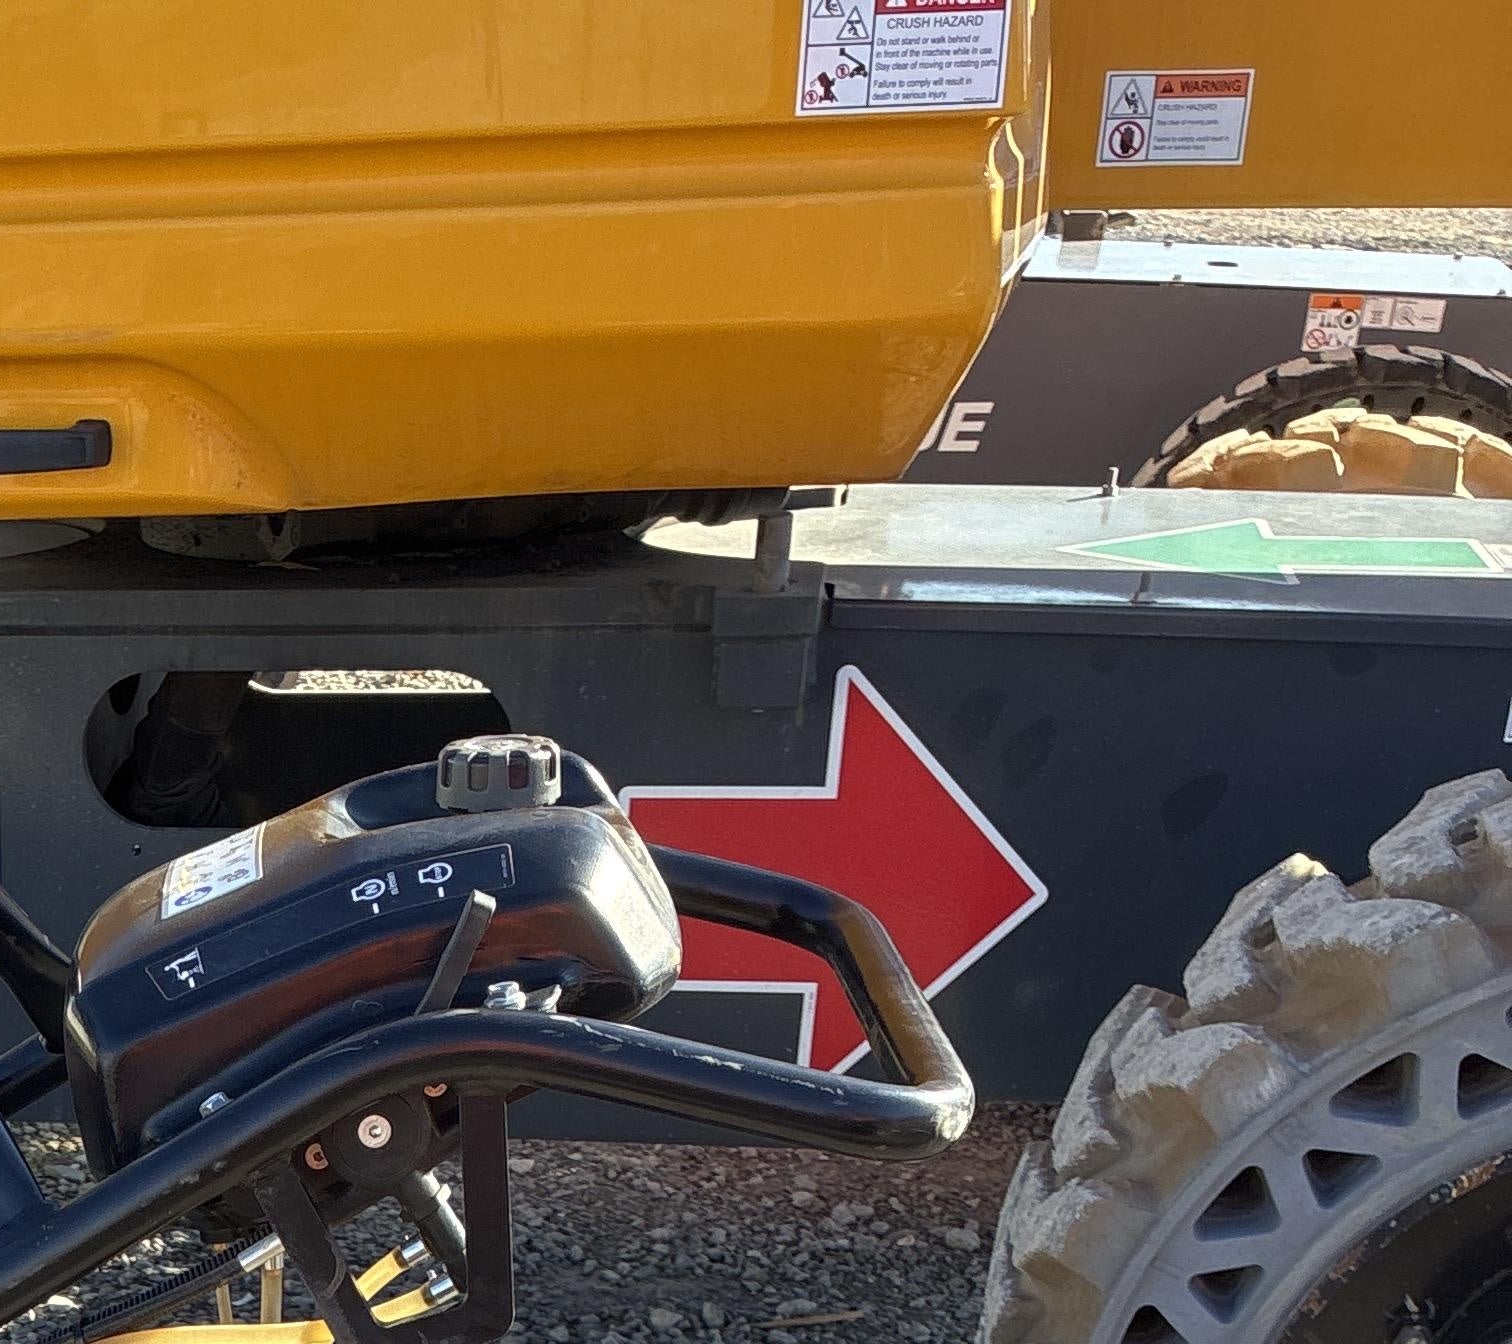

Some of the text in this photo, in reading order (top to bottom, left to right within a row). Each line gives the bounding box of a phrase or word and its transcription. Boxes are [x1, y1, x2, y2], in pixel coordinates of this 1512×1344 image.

[887, 15, 984, 29] CRUSH HAZARD
[877, 37, 886, 46] Do
[889, 37, 900, 45] not
[901, 36, 920, 45] stand
[930, 36, 946, 44] walk
[948, 35, 971, 43] behind
[884, 50, 900, 58] front
[901, 49, 908, 57] of
[909, 49, 920, 57] the
[922, 48, 950, 57] machine
[953, 47, 970, 55] while
[875, 62, 890, 72] Stay
[891, 62, 909, 70] clear
[910, 61, 918, 70] of
[918, 61, 943, 70] moving
[953, 60, 979, 69] rotating
[873, 79, 896, 88] Failure
[898, 79, 905, 88] to
[906, 78, 931, 89] comply
[932, 78, 944, 86] will
[945, 77, 964, 85] result
[1180, 79, 1242, 93] WARNING
[893, 92, 901, 100] or
[902, 91, 926, 100] serious
[919, 402, 995, 452] E
